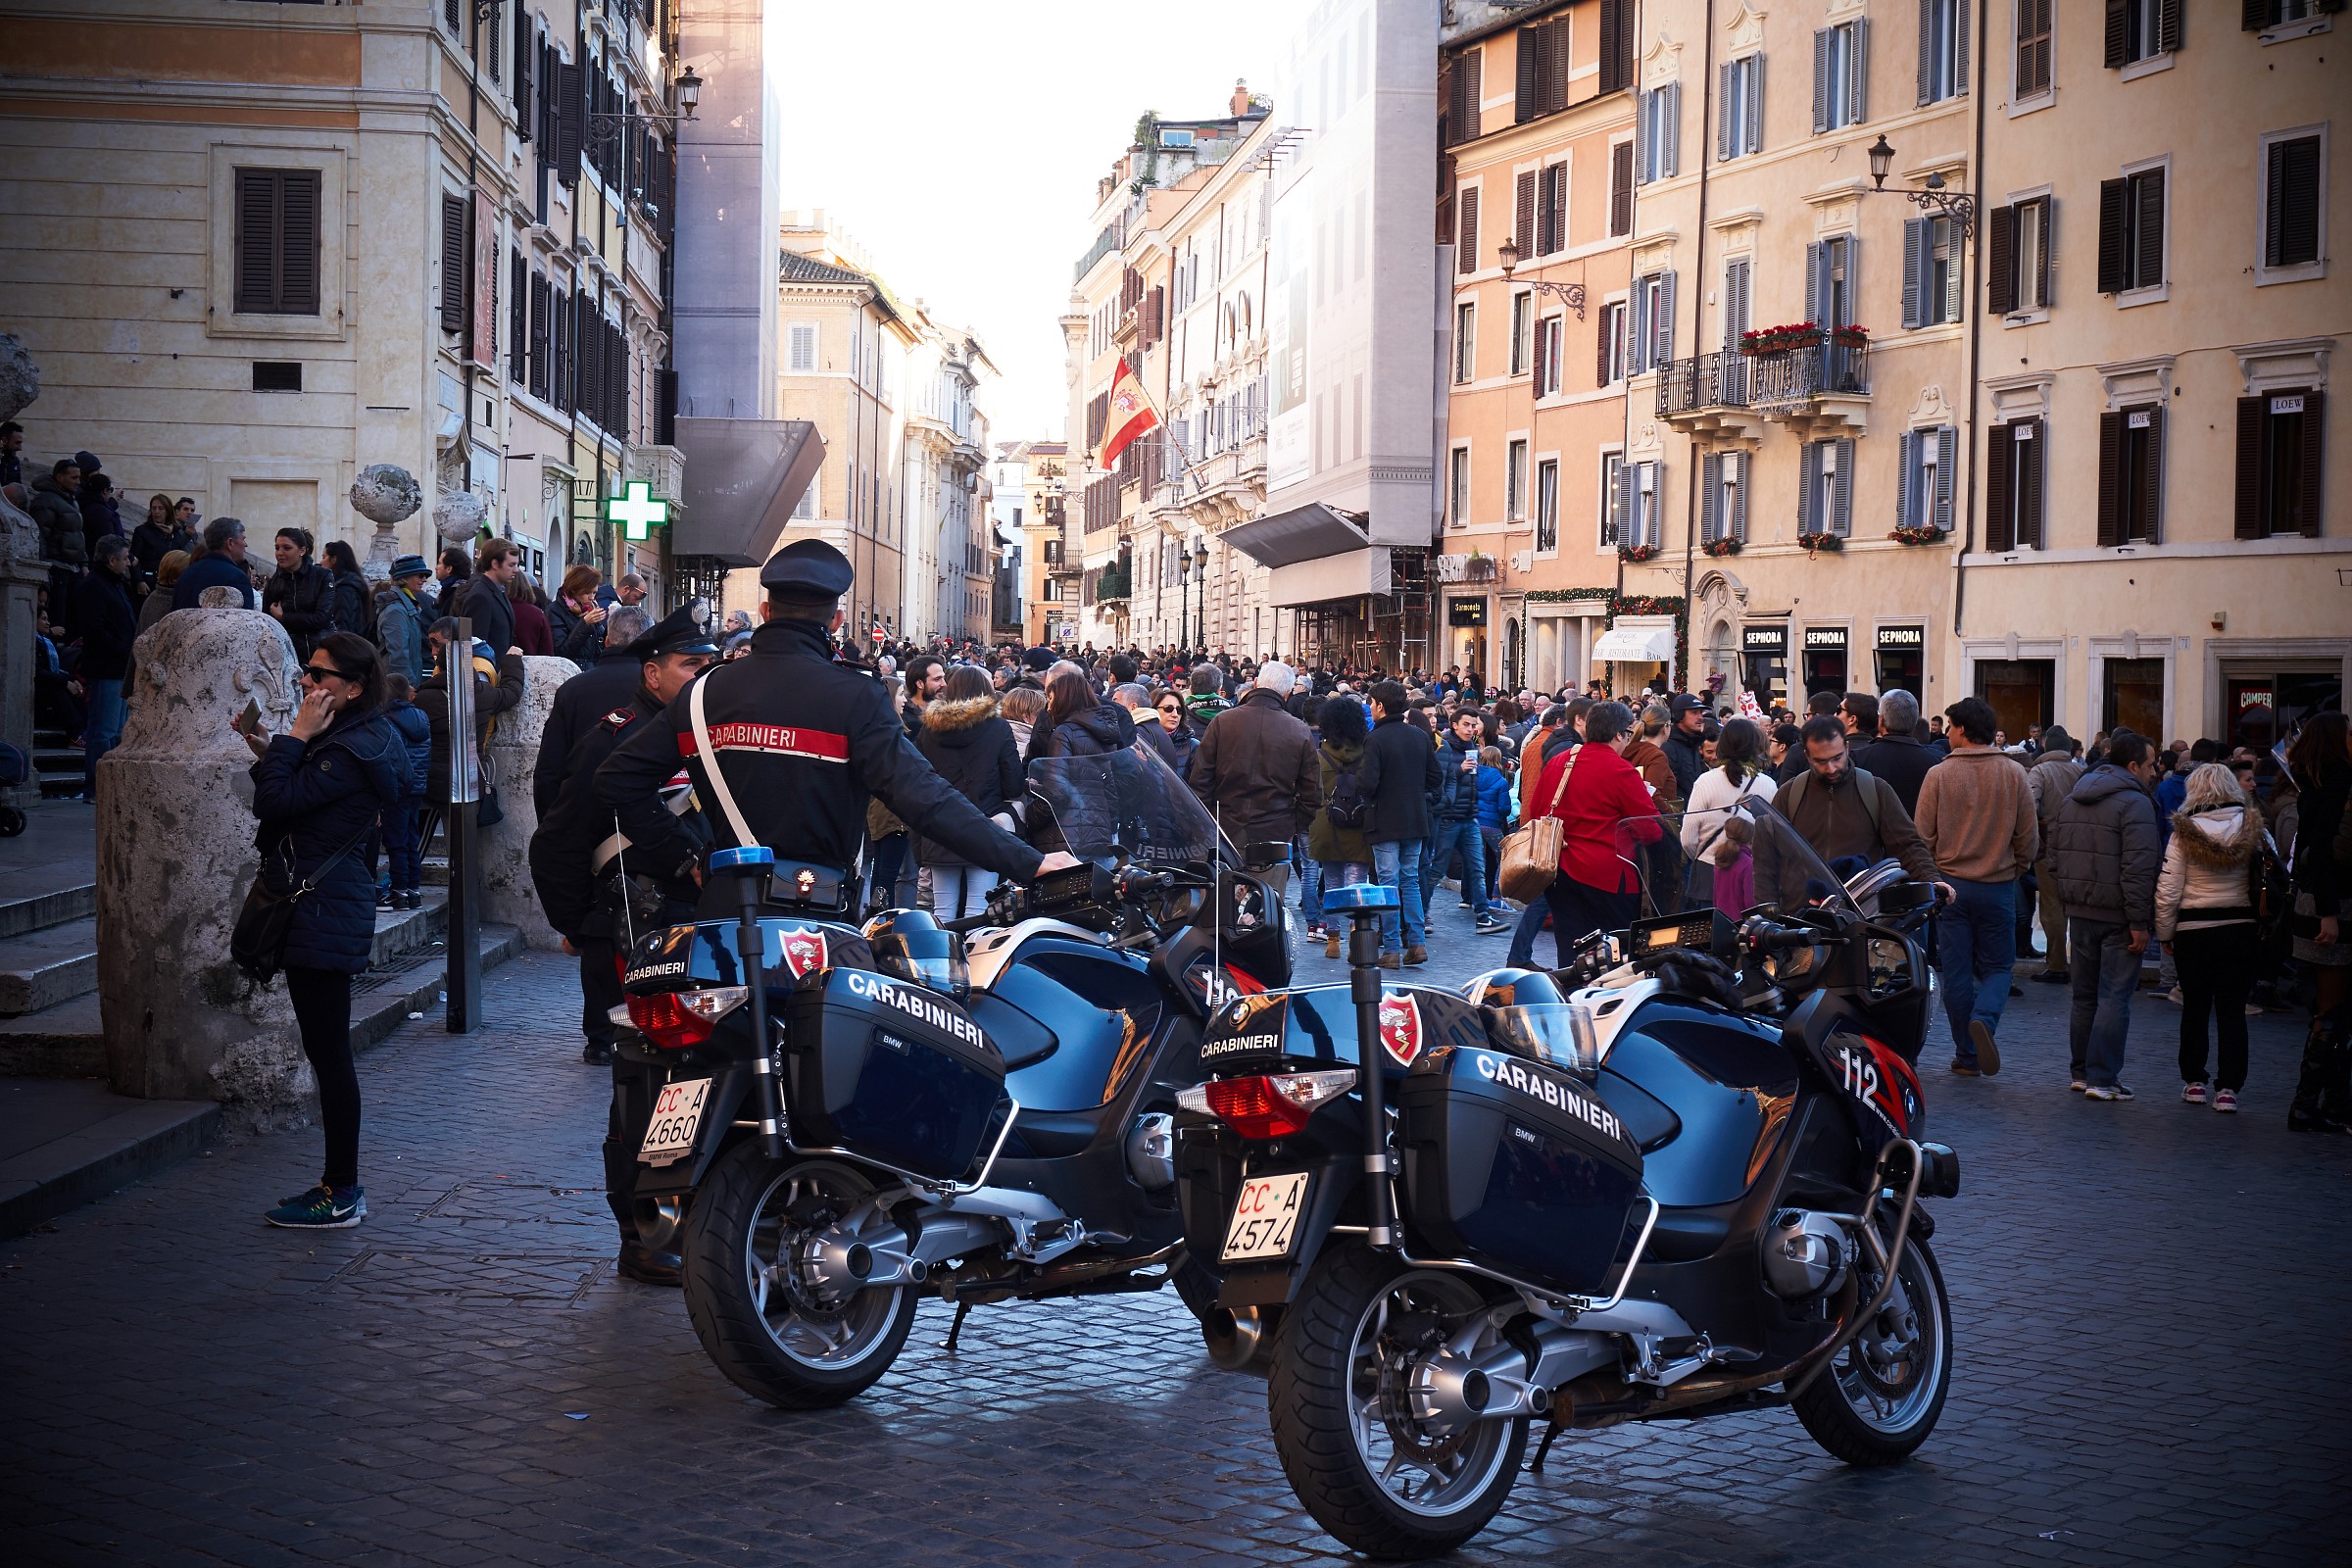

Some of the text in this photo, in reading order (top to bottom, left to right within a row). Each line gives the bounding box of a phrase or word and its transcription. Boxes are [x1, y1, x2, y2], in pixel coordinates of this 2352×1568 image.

[2275, 398, 2303, 410] LOEW
[1746, 631, 1782, 644] SEPHORA
[1806, 631, 1845, 645] SEPHORA
[1879, 630, 1921, 644] SEPHORA
[2240, 692, 2273, 709] CAMPER
[708, 725, 796, 748] CARABINIERI
[624, 961, 685, 984] CARABINIERI
[1201, 969, 1239, 1007] 11
[848, 973, 984, 1049] CARABINIERI
[883, 1034, 903, 1050] BMW
[1200, 1034, 1279, 1058] CARABINIERI
[1839, 1047, 1879, 1111] 112
[657, 1083, 706, 1114] CC A
[1476, 1054, 1621, 1142] CARABINIERI
[646, 1114, 697, 1146] 4660
[1515, 1127, 1536, 1143] BMW
[1239, 1179, 1299, 1214] CC A
[1227, 1216, 1293, 1252] 4574
[1421, 1326, 1436, 1341] BMW
